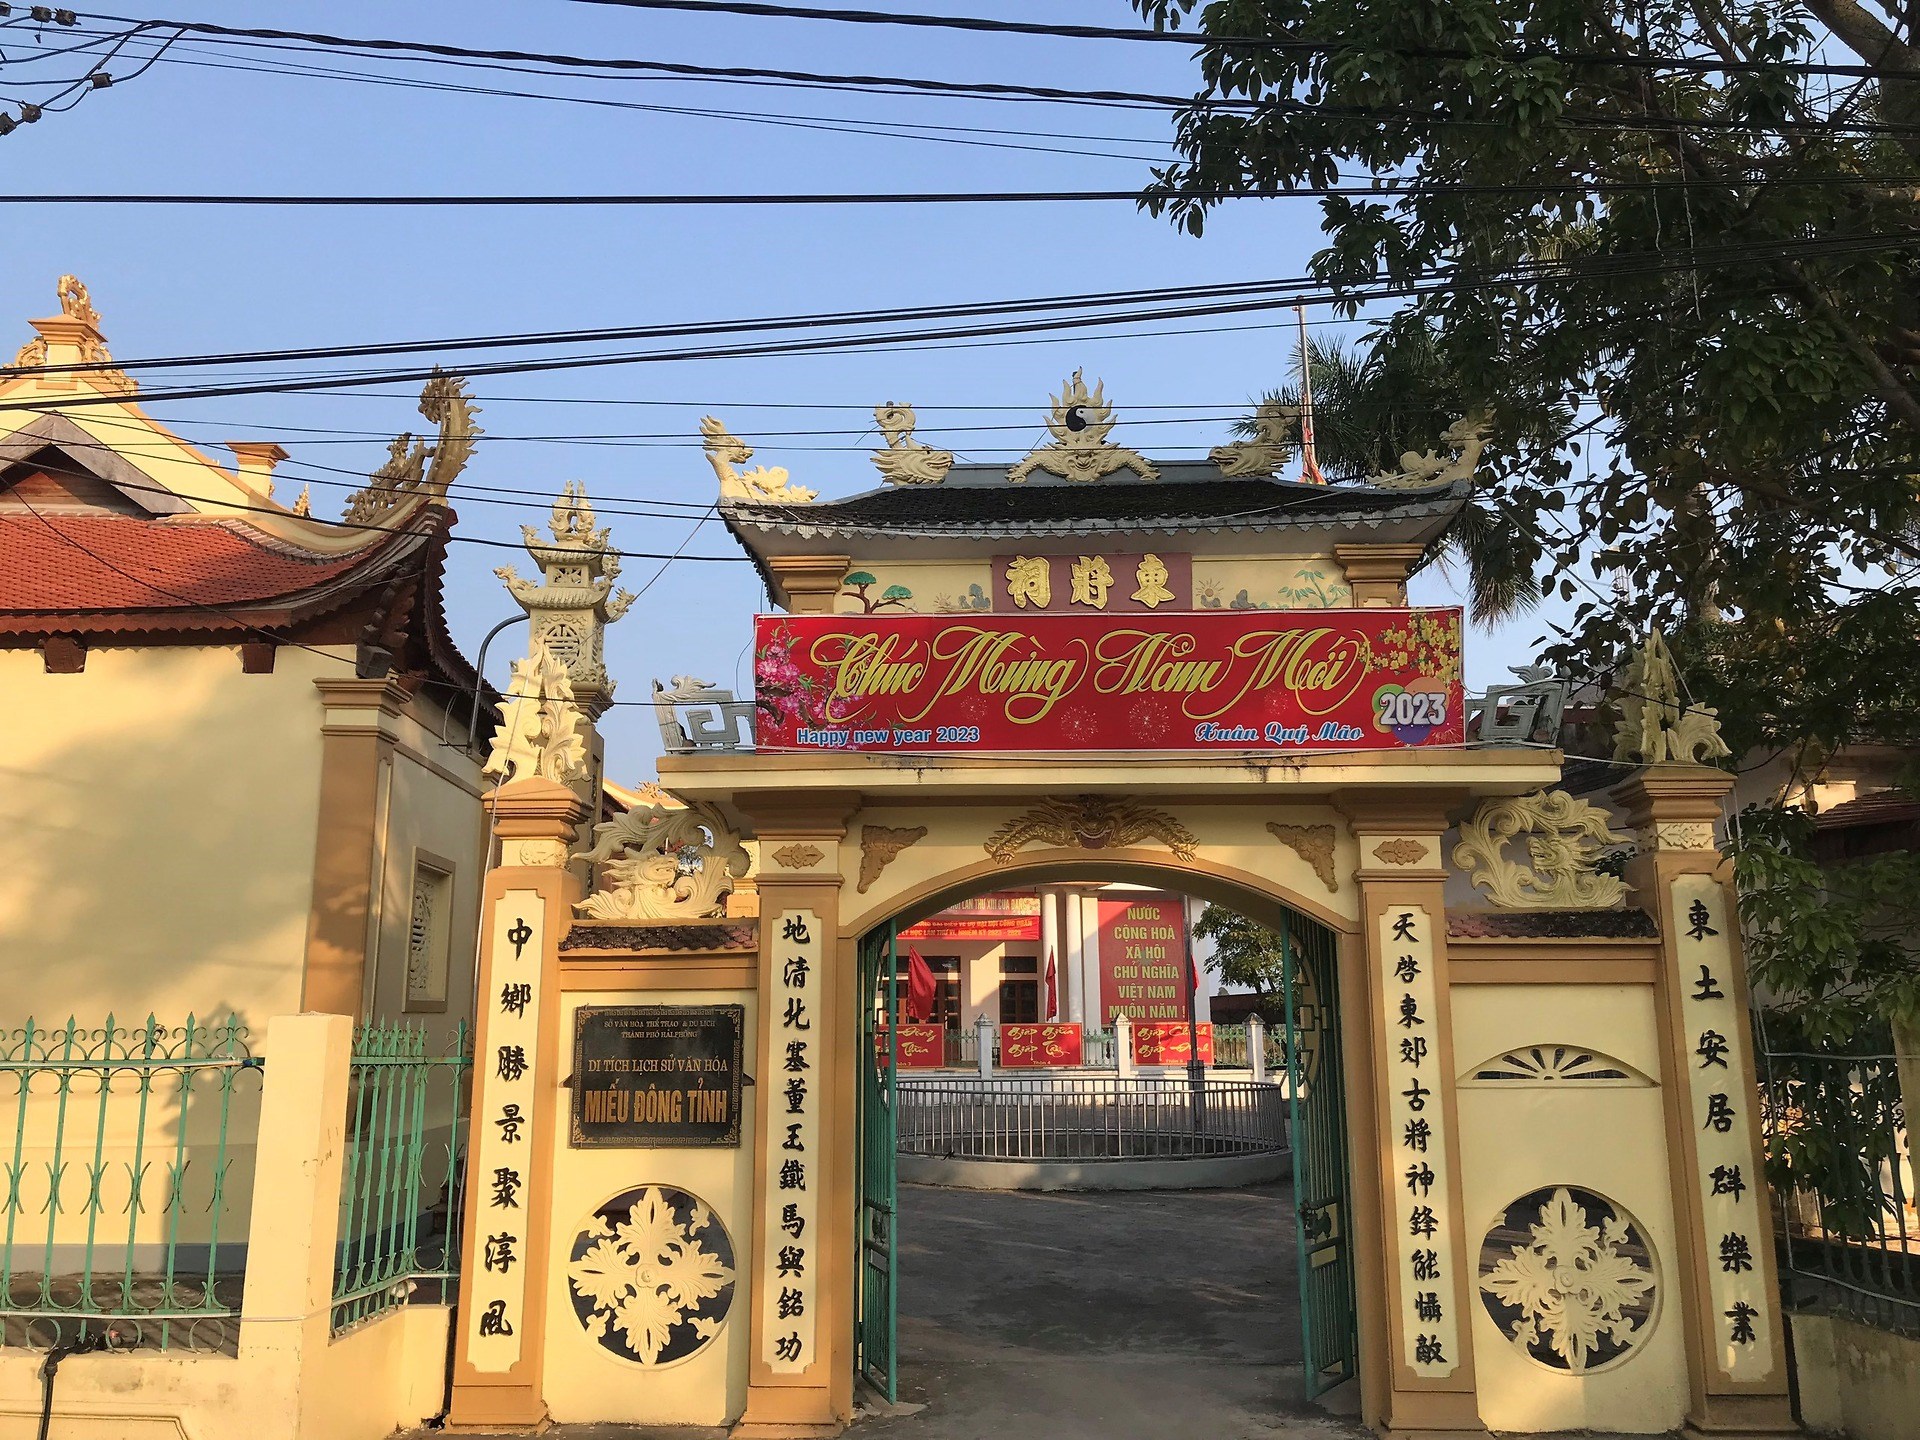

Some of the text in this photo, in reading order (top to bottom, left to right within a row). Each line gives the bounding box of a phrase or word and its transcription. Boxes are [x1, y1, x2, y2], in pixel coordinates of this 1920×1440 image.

[810, 626, 1369, 724] Chúc Mừng Năm Mới
[1379, 691, 1446, 726] 2023
[797, 726, 980, 746] Happy new year 2023
[1194, 721, 1364, 744] Xuân Quý Mão
[1127, 904, 1160, 920] NƯỚC
[1114, 924, 1147, 942] CỘNG
[1126, 944, 1166, 962] XÃ HỘI
[1113, 961, 1180, 979] CHỦ NGHĨA
[1118, 983, 1176, 1001] VIỆT NAM
[1109, 1003, 1146, 1018] MUÔN
[1149, 1003, 1178, 1018] NĂM
[588, 1053, 728, 1076] DI TÍCH LỊCH SỬ VĂN HÓA
[584, 1077, 727, 1123] MIẾU ĐÔNG TỈNH
